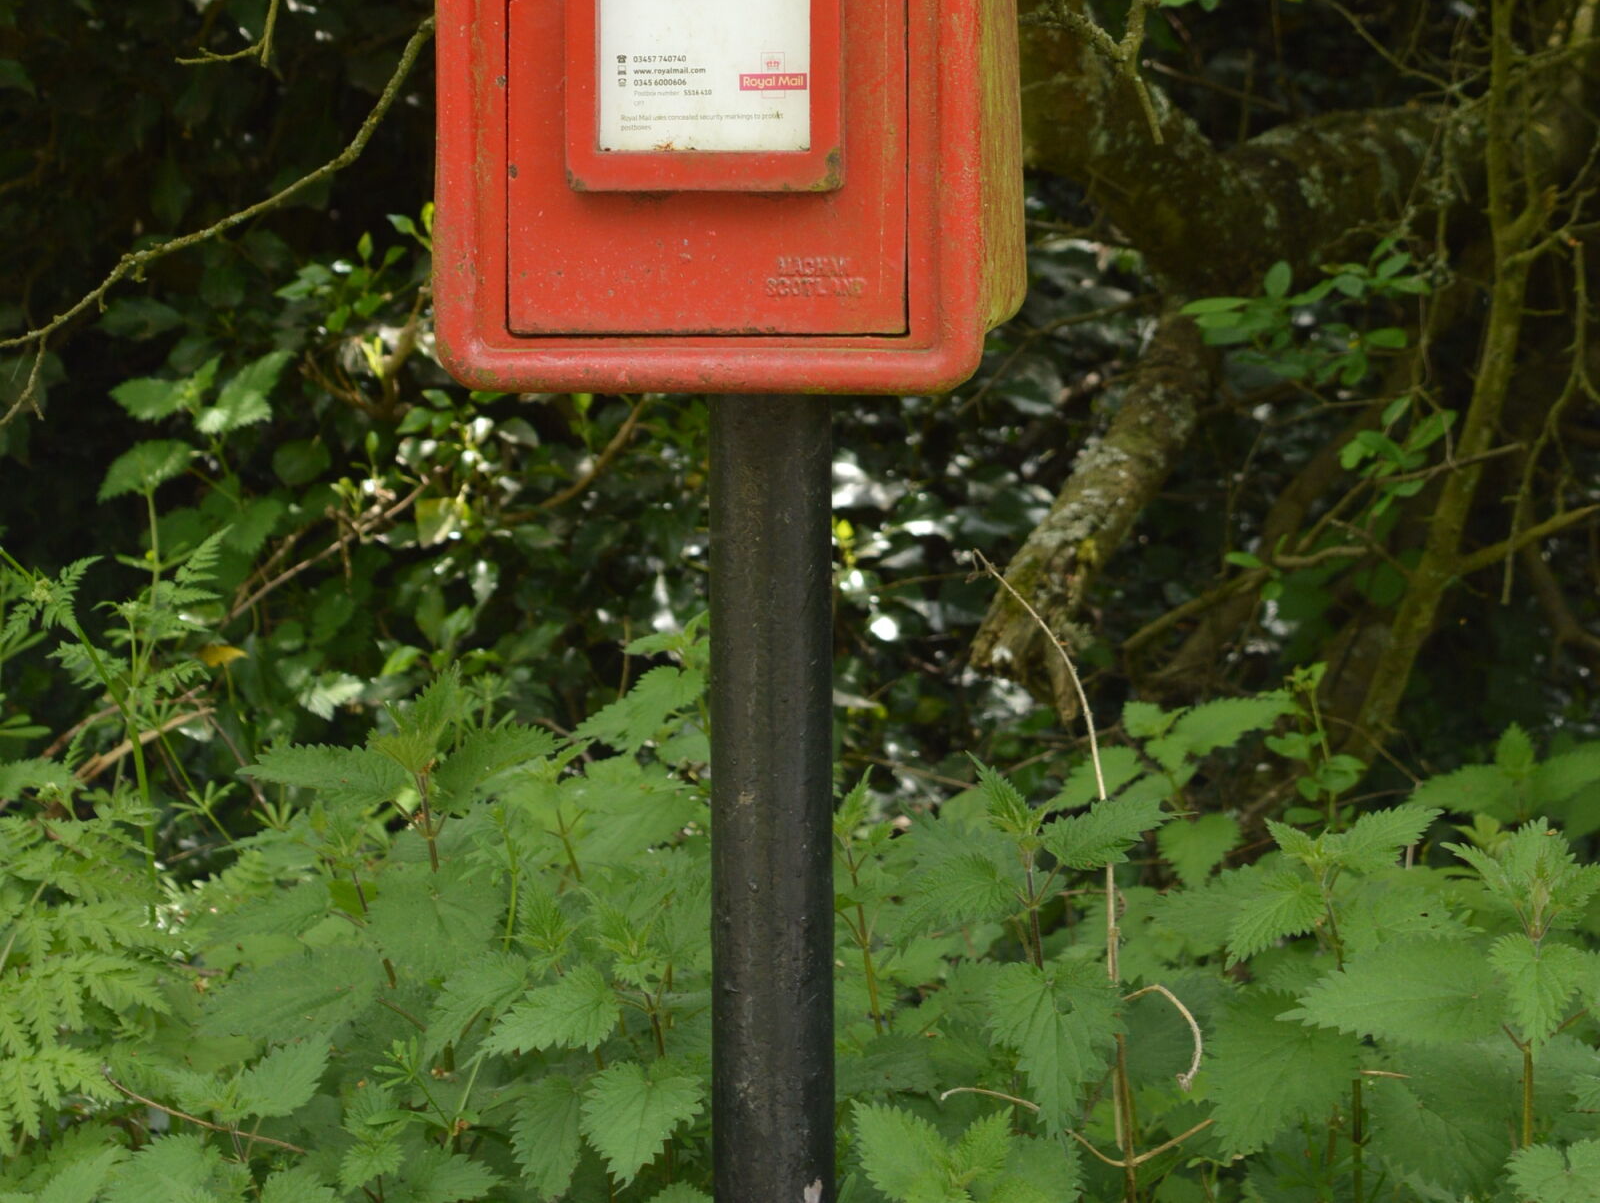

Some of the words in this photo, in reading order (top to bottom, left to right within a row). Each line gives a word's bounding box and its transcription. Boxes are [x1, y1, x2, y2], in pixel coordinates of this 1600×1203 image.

[633, 55, 657, 64] 03457
[658, 54, 687, 63] 740740
[633, 66, 706, 76] www.royalmail.com
[633, 78, 652, 87] 0345
[742, 75, 776, 89] Royal
[777, 75, 804, 87] Mail
